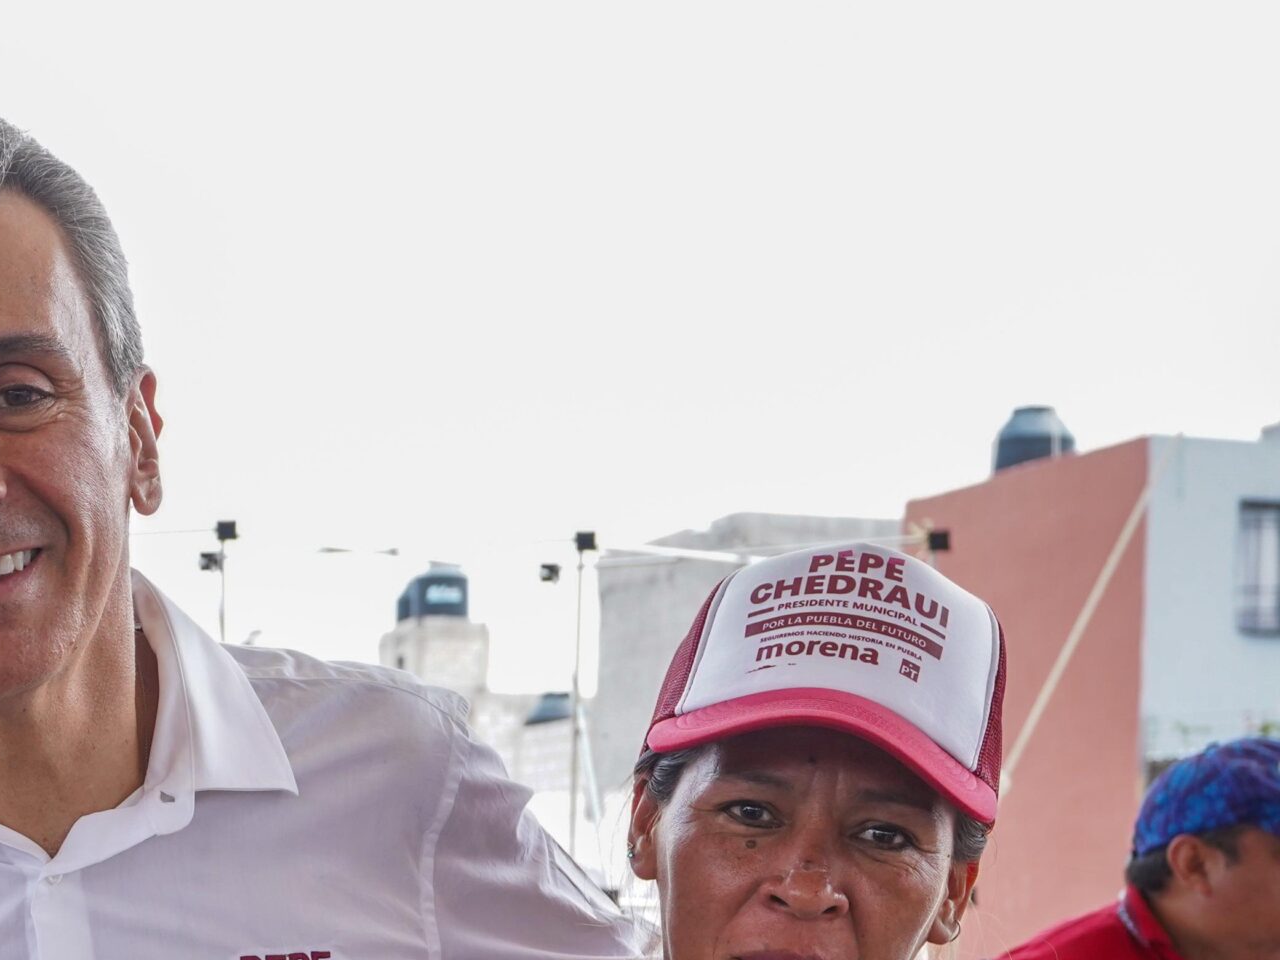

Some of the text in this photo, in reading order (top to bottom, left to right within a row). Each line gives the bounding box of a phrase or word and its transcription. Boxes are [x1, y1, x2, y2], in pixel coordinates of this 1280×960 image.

[809, 550, 905, 582] PEPE
[750, 575, 949, 628] CHEDRAUI
[778, 599, 918, 626] PRESIDENTE MUNICIPAL
[760, 630, 922, 661] SEGUIREMOS HACIENDO HISTORIA EN PUEBLA
[762, 615, 926, 648] POR LA PUEBLA DEL FUTURO
[756, 640, 878, 665] morena
[901, 664, 918, 679] PT
